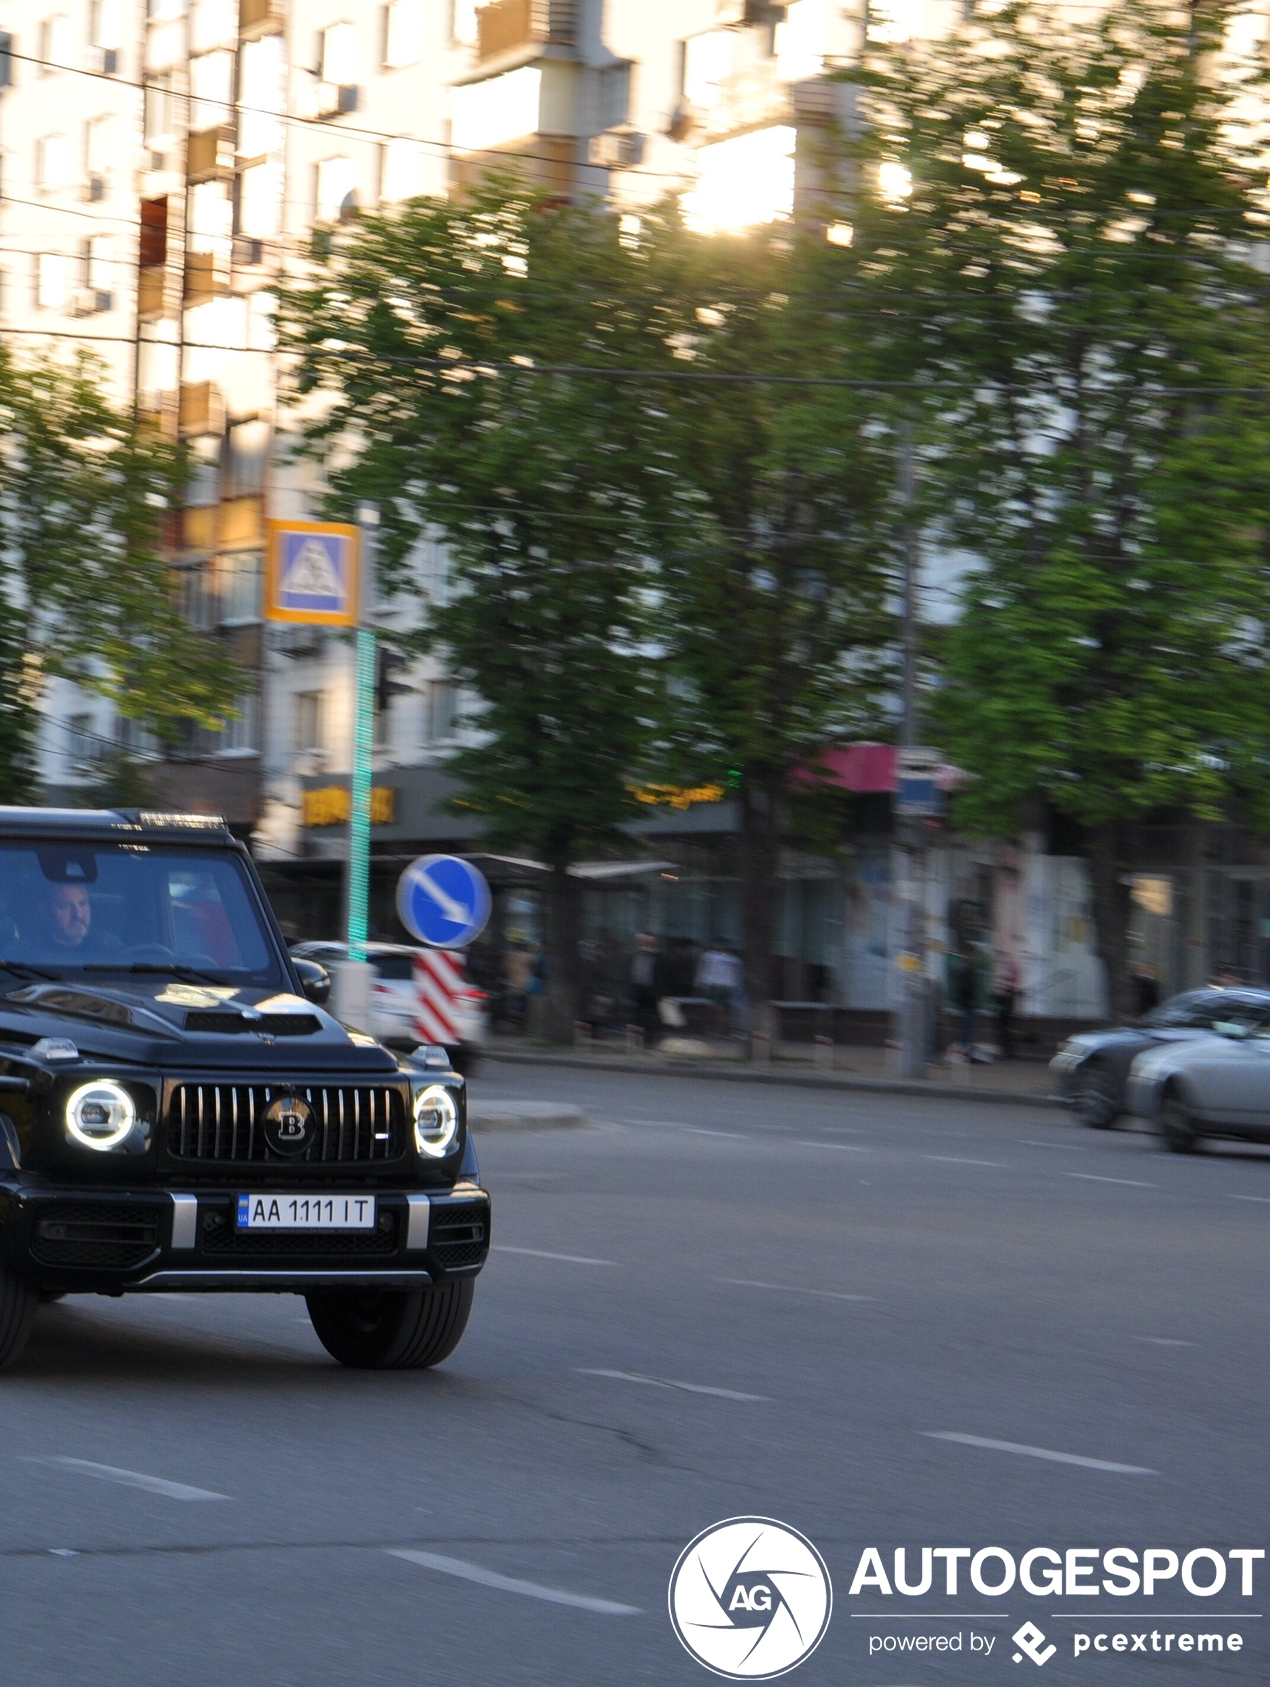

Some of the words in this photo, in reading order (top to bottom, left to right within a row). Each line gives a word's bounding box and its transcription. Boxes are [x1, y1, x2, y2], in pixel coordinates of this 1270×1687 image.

[278, 1111, 306, 1140] B
[238, 1213, 248, 1222] UA
[252, 1199, 281, 1222] AA
[288, 1199, 334, 1222] 1111
[344, 1200, 369, 1222] IT
